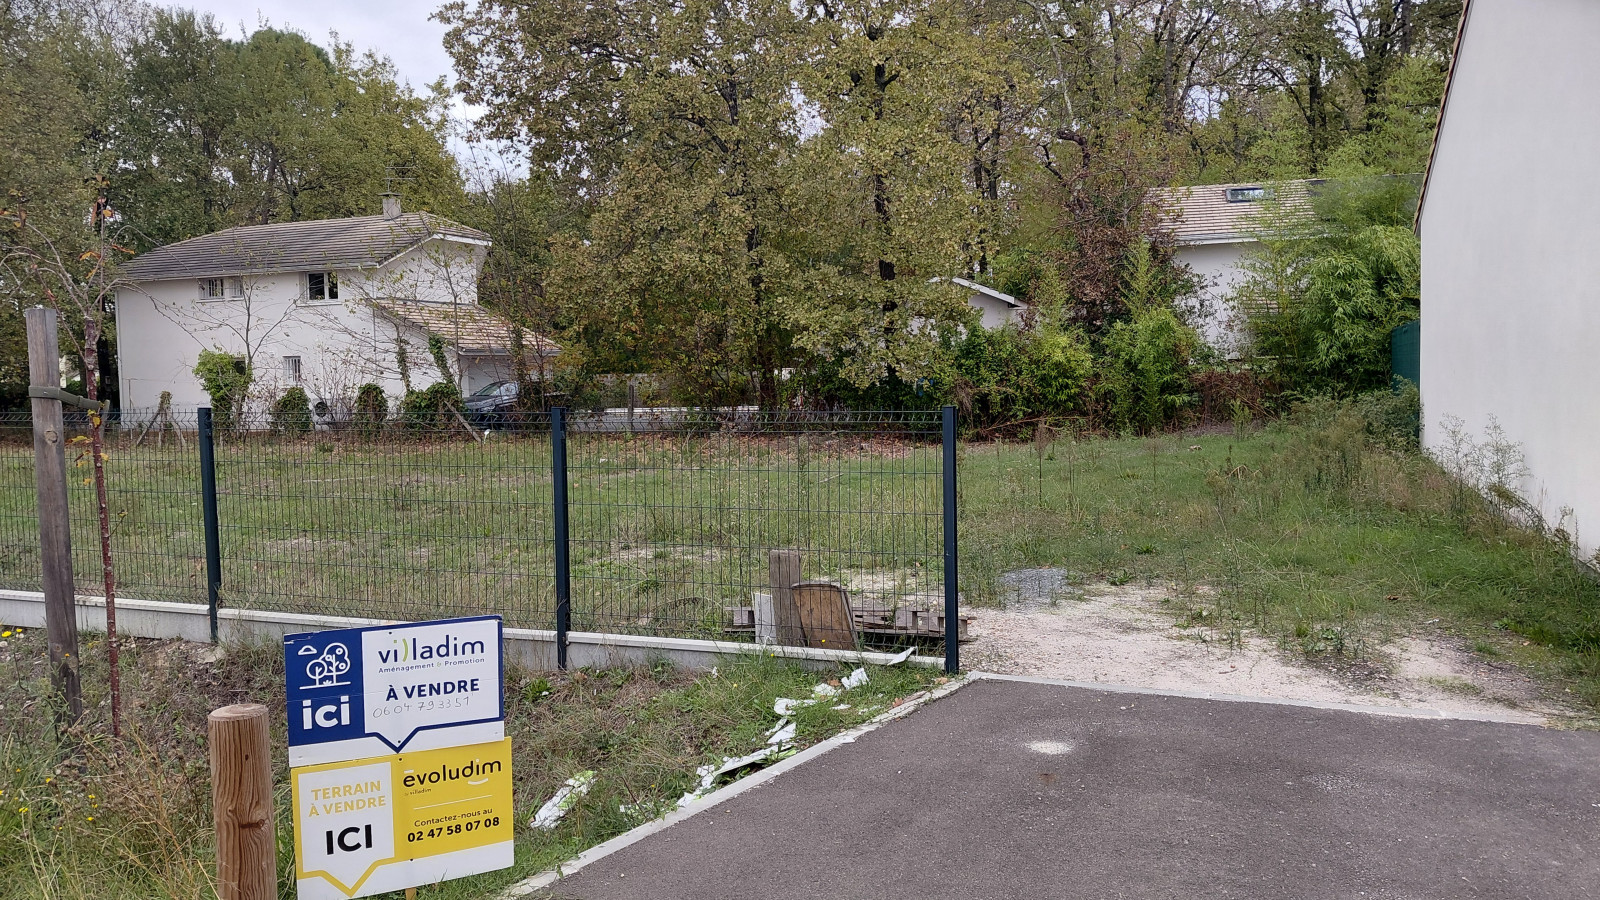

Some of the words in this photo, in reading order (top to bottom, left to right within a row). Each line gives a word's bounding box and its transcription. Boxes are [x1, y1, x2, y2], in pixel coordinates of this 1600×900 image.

[378, 634, 485, 664] villadim
[378, 662, 435, 674] Aménagement
[444, 658, 485, 667] Promotion
[386, 684, 399, 701] À
[403, 678, 480, 699] VENDRE
[302, 695, 351, 730] ici
[311, 780, 381, 801] TERRAIN
[308, 803, 320, 818] À
[323, 795, 387, 816] VENDRE
[414, 810, 481, 827] Contactez-nous
[483, 807, 493, 816] au
[326, 824, 373, 855] ICI
[407, 831, 424, 843] 02
[427, 827, 443, 840] 47
[446, 824, 462, 836] 58
[465, 820, 480, 833] 07
[484, 816, 500, 828] 08
